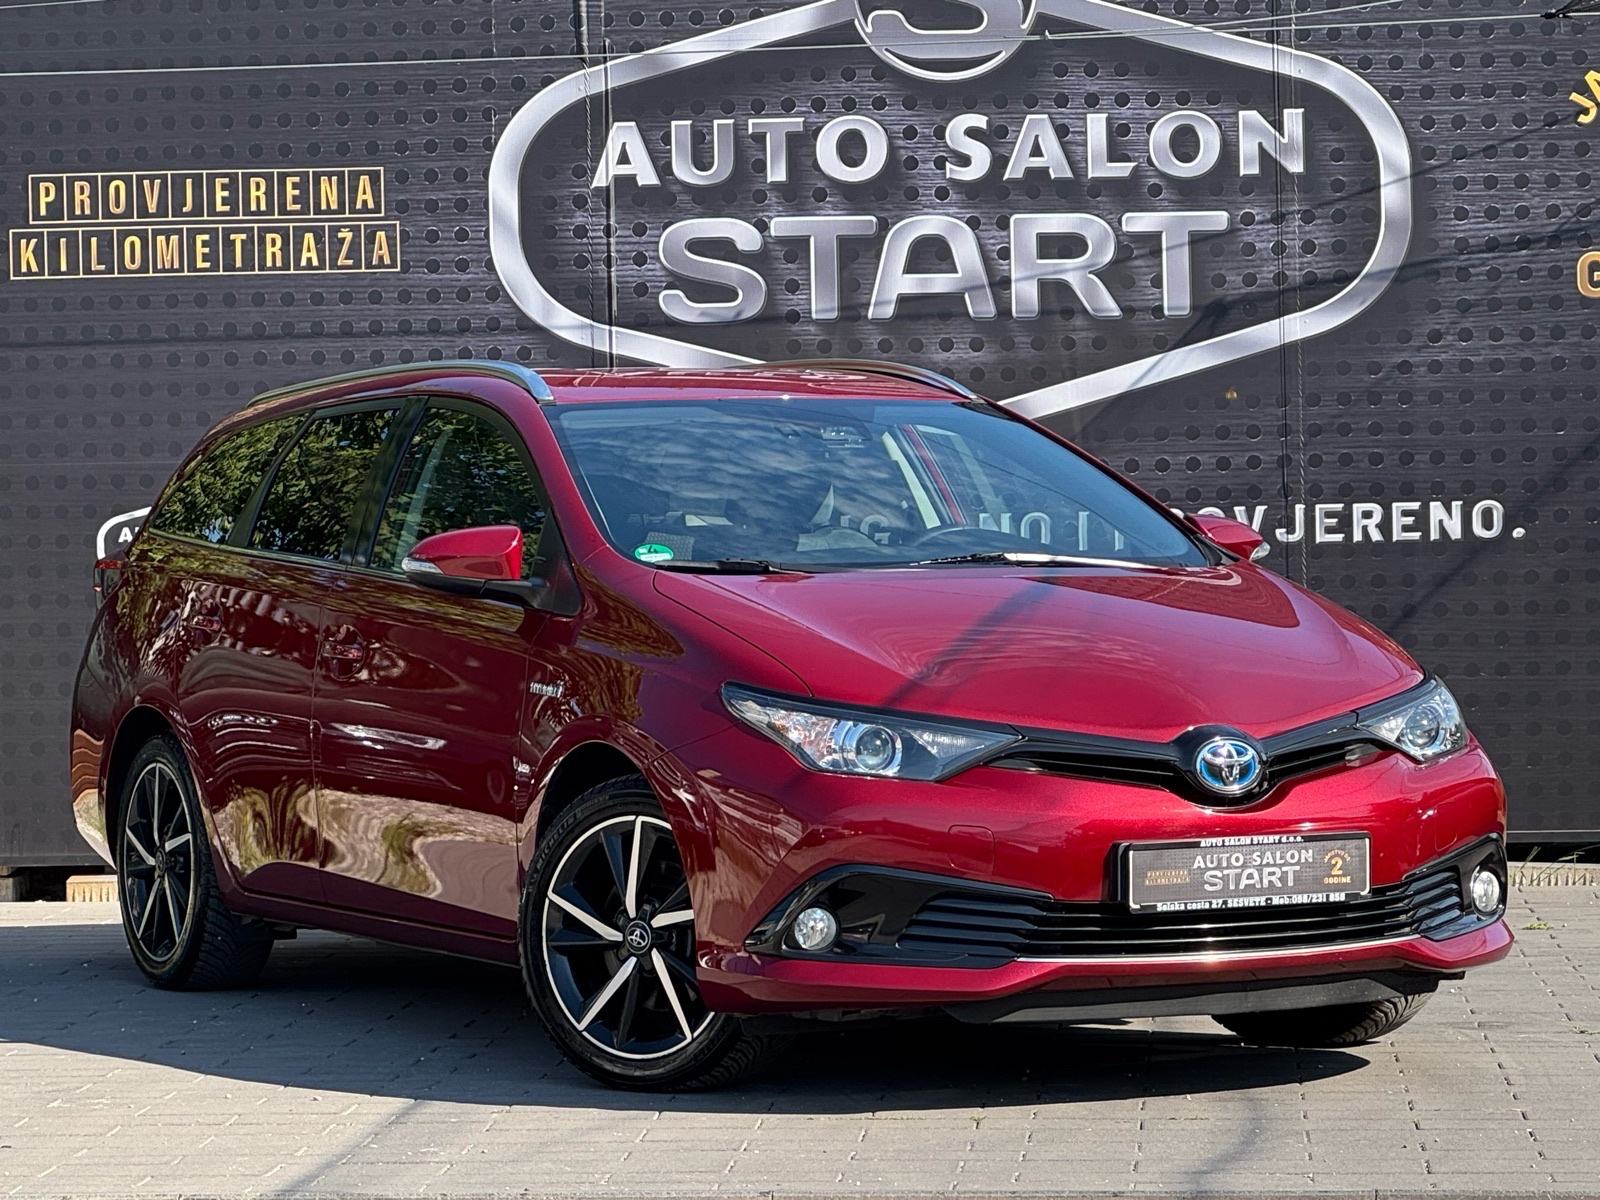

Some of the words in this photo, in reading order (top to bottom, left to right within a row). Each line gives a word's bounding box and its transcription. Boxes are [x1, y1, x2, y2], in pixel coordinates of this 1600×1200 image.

[592, 115, 889, 188] AUTO
[945, 107, 1306, 182] SALON
[38, 174, 375, 217] PROVJERENA
[19, 228, 392, 274] KILOMETRAŽA
[657, 210, 1229, 325] START
[1200, 838, 1223, 847] AUTO
[1224, 837, 1251, 846] SALON
[1252, 835, 1280, 844] START
[1193, 852, 1244, 869] AUTO
[1252, 849, 1313, 866] SALON
[1331, 856, 1343, 875] 2
[1204, 865, 1300, 892] START
[1227, 896, 1266, 908] SESVETE
